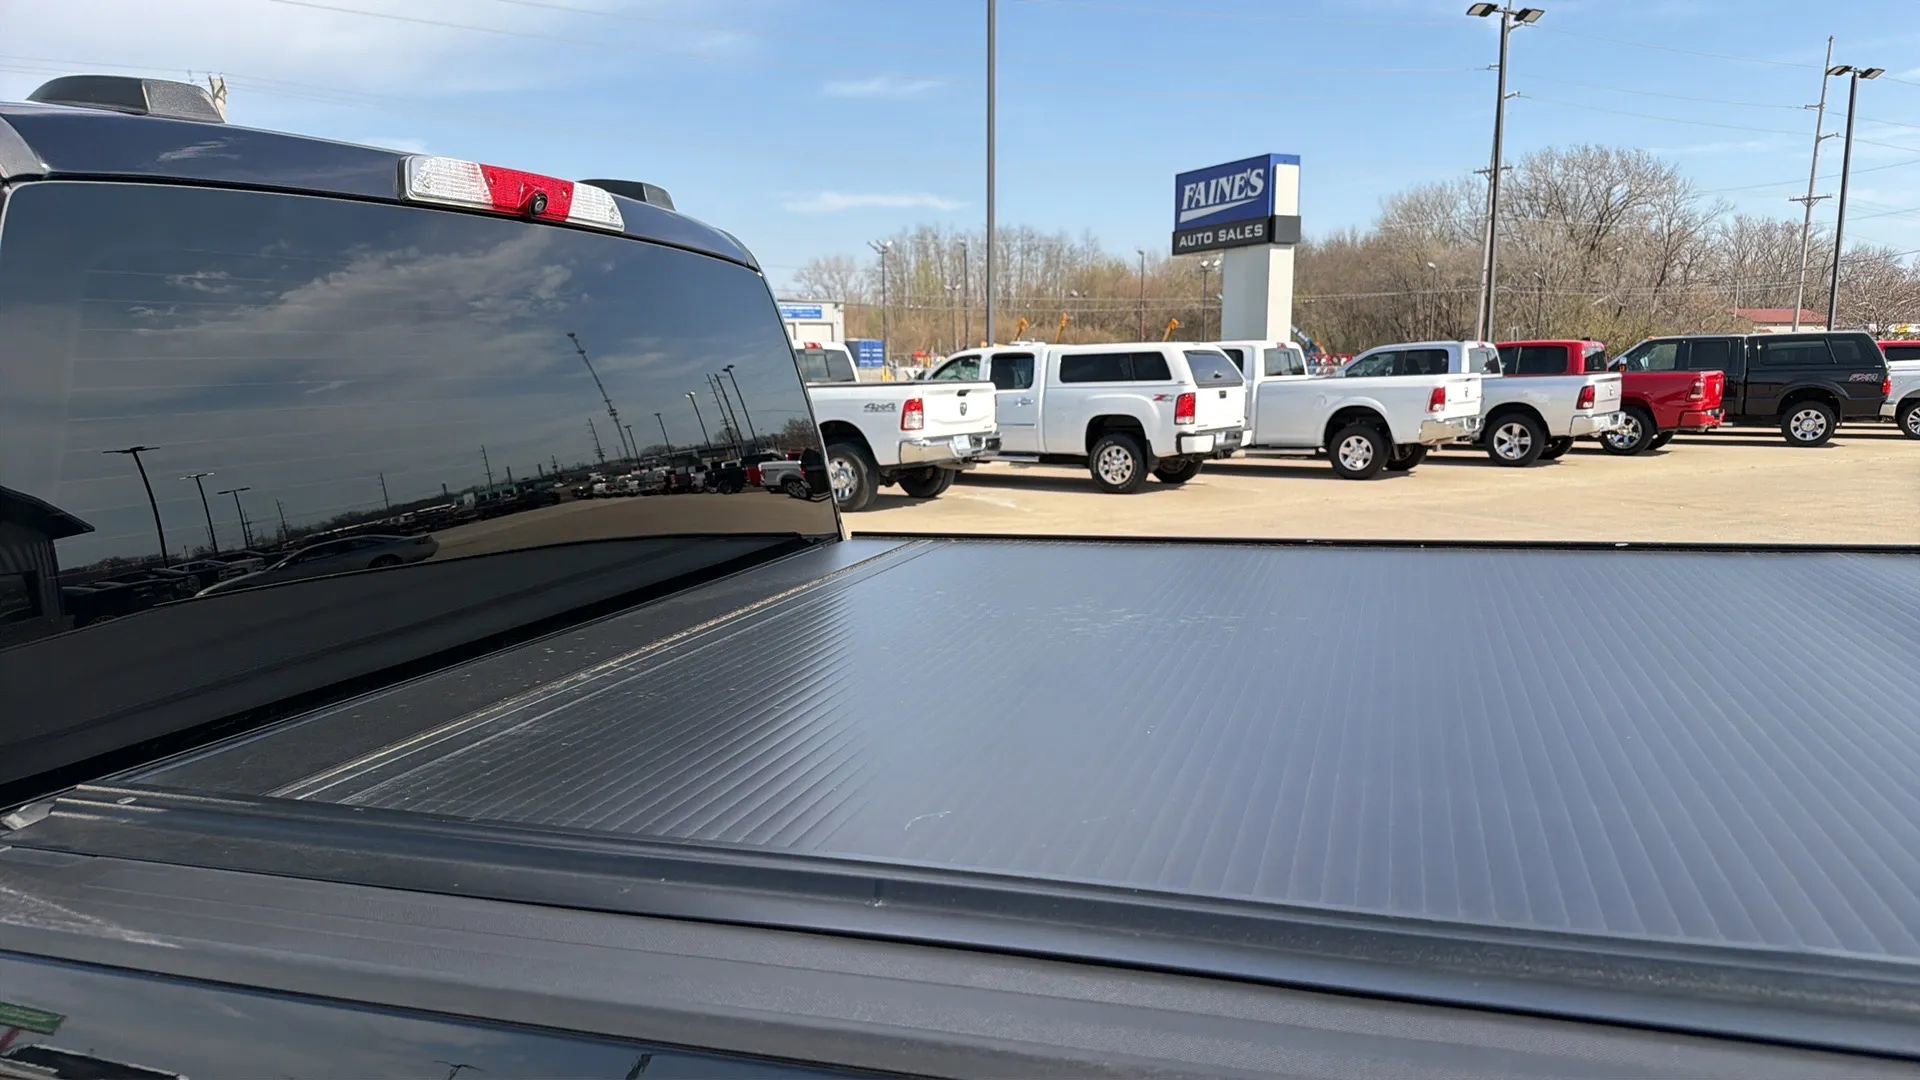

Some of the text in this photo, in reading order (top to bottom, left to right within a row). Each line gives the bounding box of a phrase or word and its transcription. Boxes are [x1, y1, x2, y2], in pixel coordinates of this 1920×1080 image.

[1182, 168, 1265, 210] FAINE'S
[1179, 224, 1263, 248] AUTO SALES
